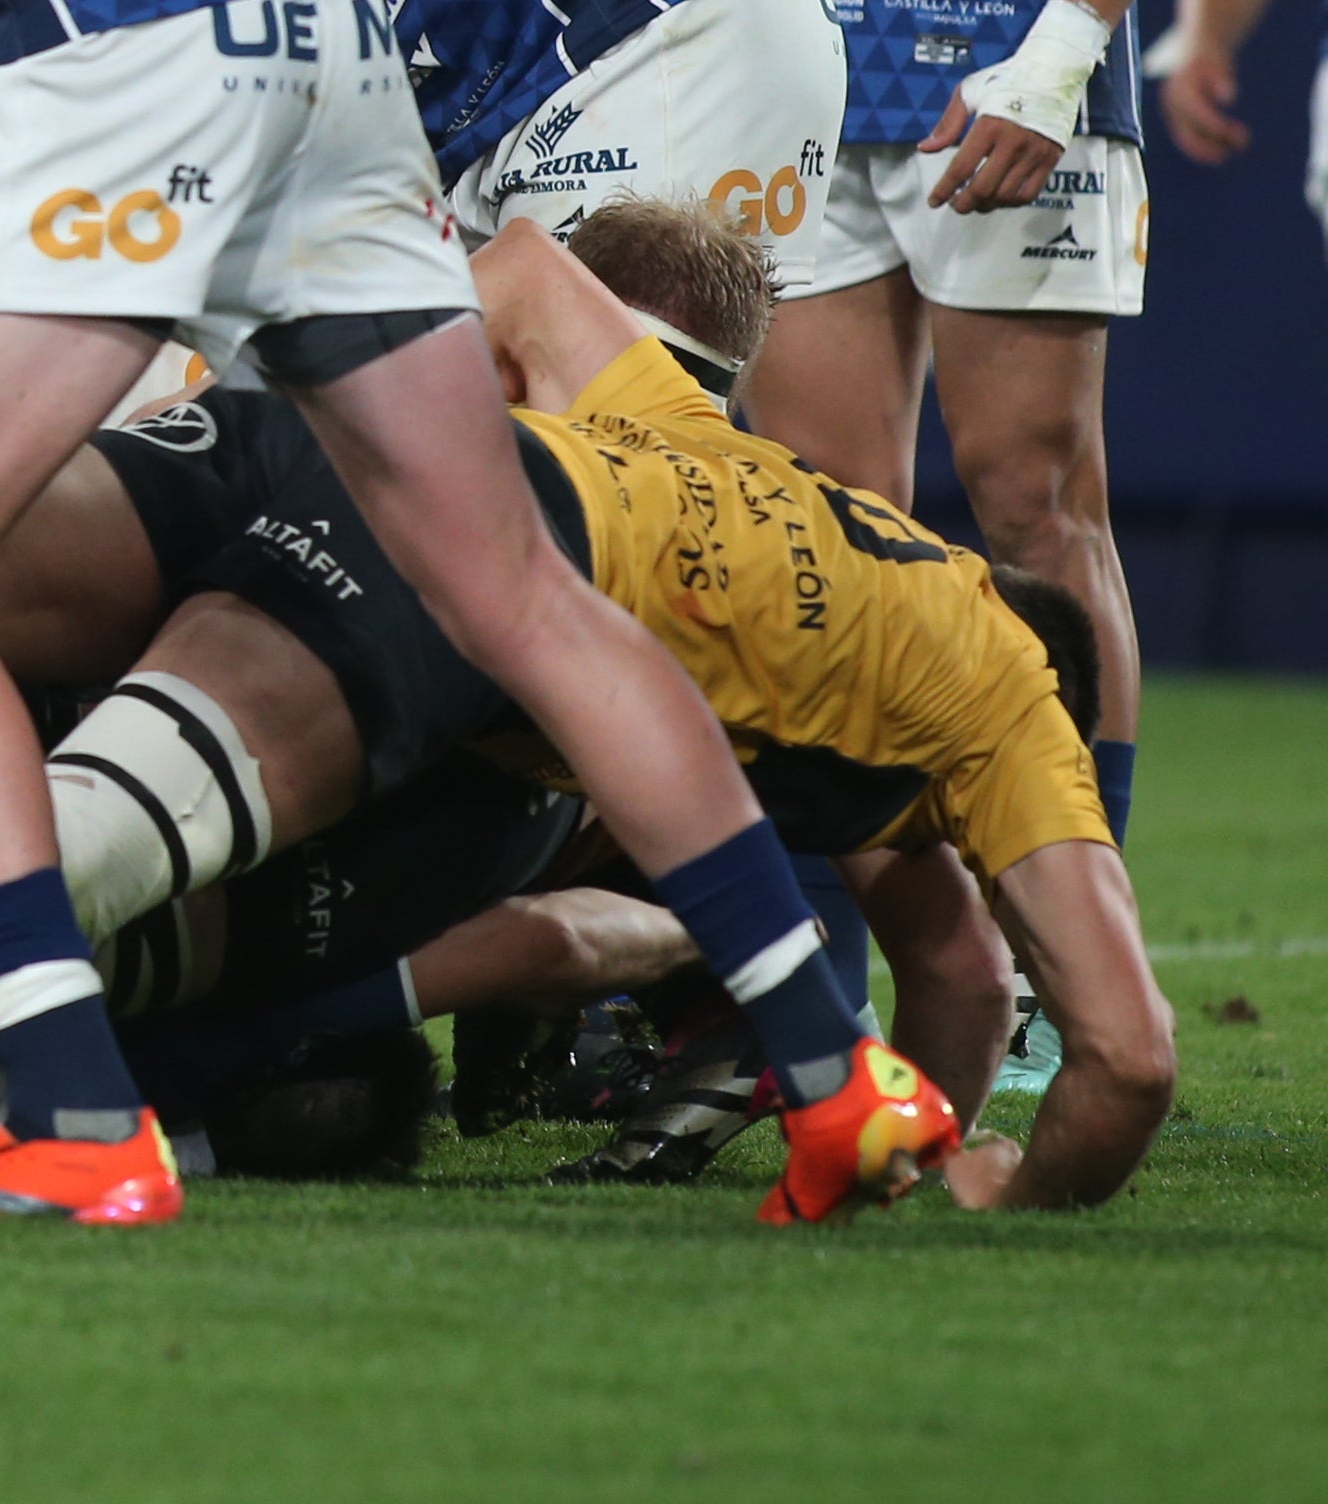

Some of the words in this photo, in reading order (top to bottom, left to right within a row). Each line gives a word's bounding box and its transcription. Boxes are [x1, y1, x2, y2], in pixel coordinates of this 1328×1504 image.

[959, 0, 969, 15] Y
[530, 146, 639, 180] RURAL
[707, 165, 807, 238] GO
[799, 139, 825, 178] fit
[30, 186, 185, 264] GO
[167, 163, 214, 203] fit
[1021, 246, 1097, 261] MERCURY
[244, 515, 364, 600] ALTAFIT
[784, 520, 833, 632] LEÓN
